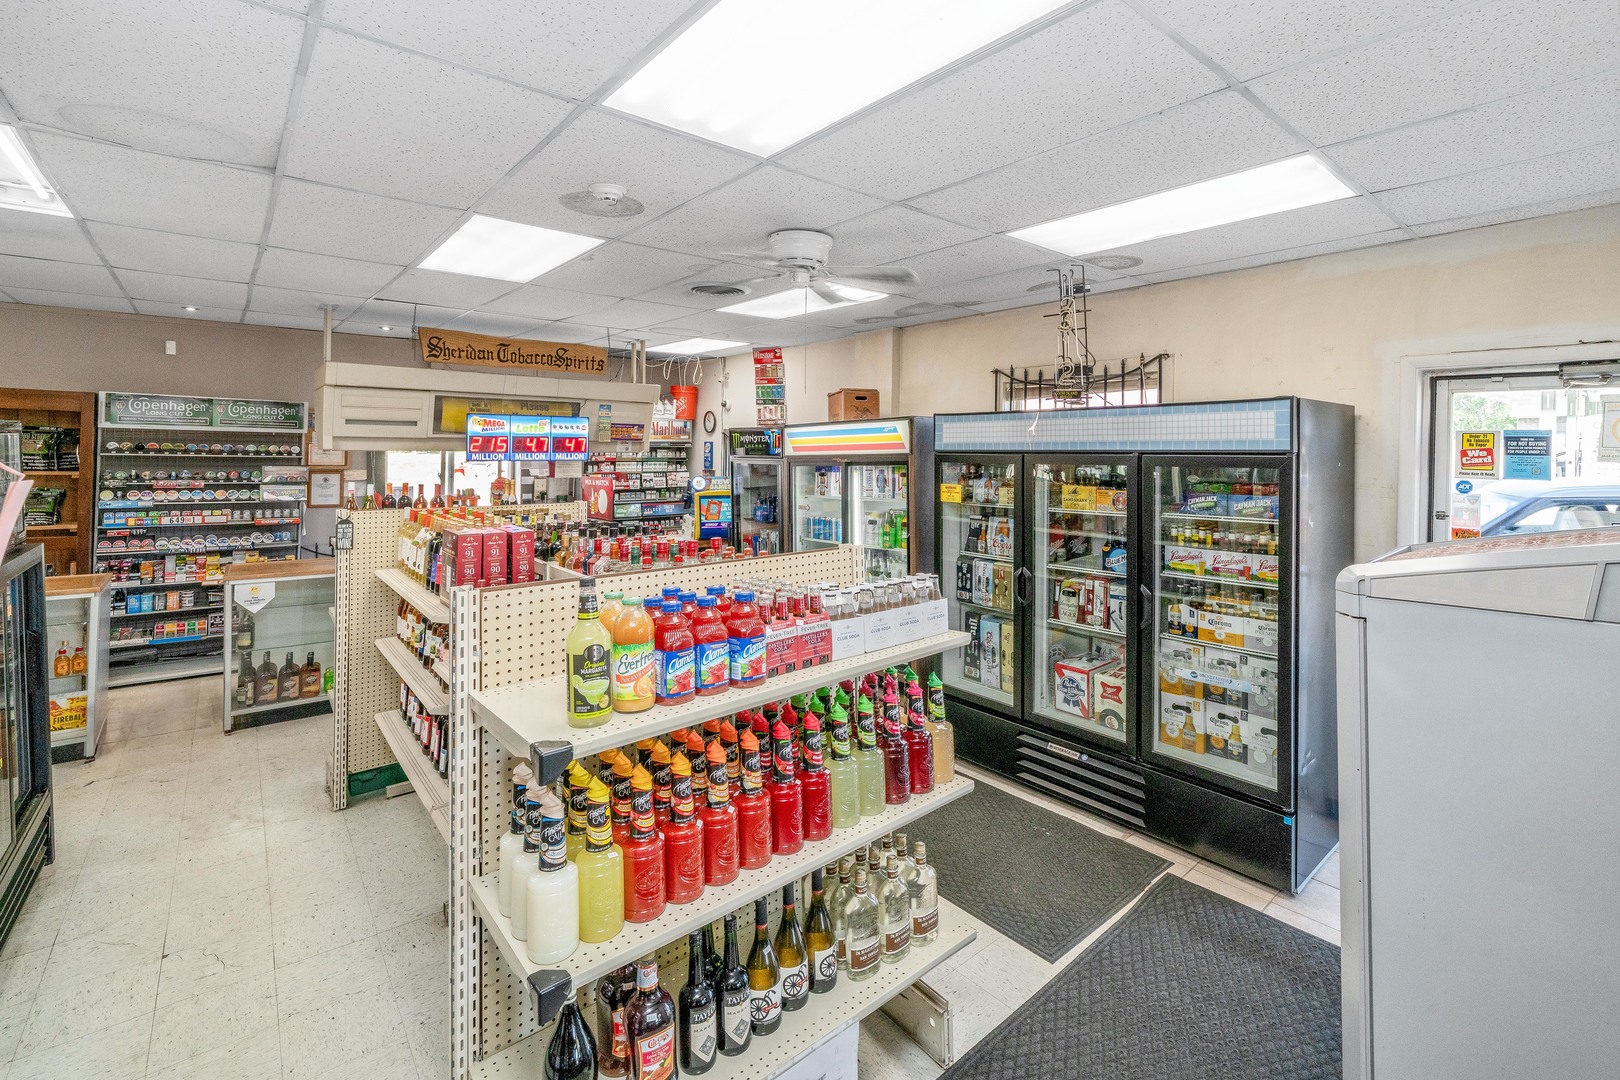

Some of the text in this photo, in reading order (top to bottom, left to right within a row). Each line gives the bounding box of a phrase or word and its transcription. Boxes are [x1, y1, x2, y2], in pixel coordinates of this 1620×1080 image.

[426, 336, 494, 361] Sheridan
[128, 397, 206, 417] Copenhagen
[228, 402, 297, 420] Copenhagen
[483, 418, 505, 427] MEGA
[516, 424, 545, 432] Lotto
[469, 436, 508, 452] 215
[1462, 455, 1493, 464] Card
[1188, 496, 1206, 505] CAYMAN
[1234, 499, 1272, 511] CAYMAN JACK
[337, 538, 352, 549] WINE
[992, 539, 1012, 550] Coors
[801, 623, 829, 632] FEVER-TREE
[1208, 617, 1232, 628] Corona
[1257, 624, 1278, 632] Corona
[767, 630, 795, 640] FEVER-TREE
[802, 631, 829, 641] DISTILLERS
[1254, 629, 1278, 637] PREMIE
[768, 638, 795, 649] DISTILLERS
[774, 645, 788, 653] COLA
[580, 666, 608, 675] MARGARITA
[583, 660, 606, 671] Original
[632, 790, 652, 804] Finest
[588, 802, 610, 818] Finest
[542, 820, 564, 837] Finest
